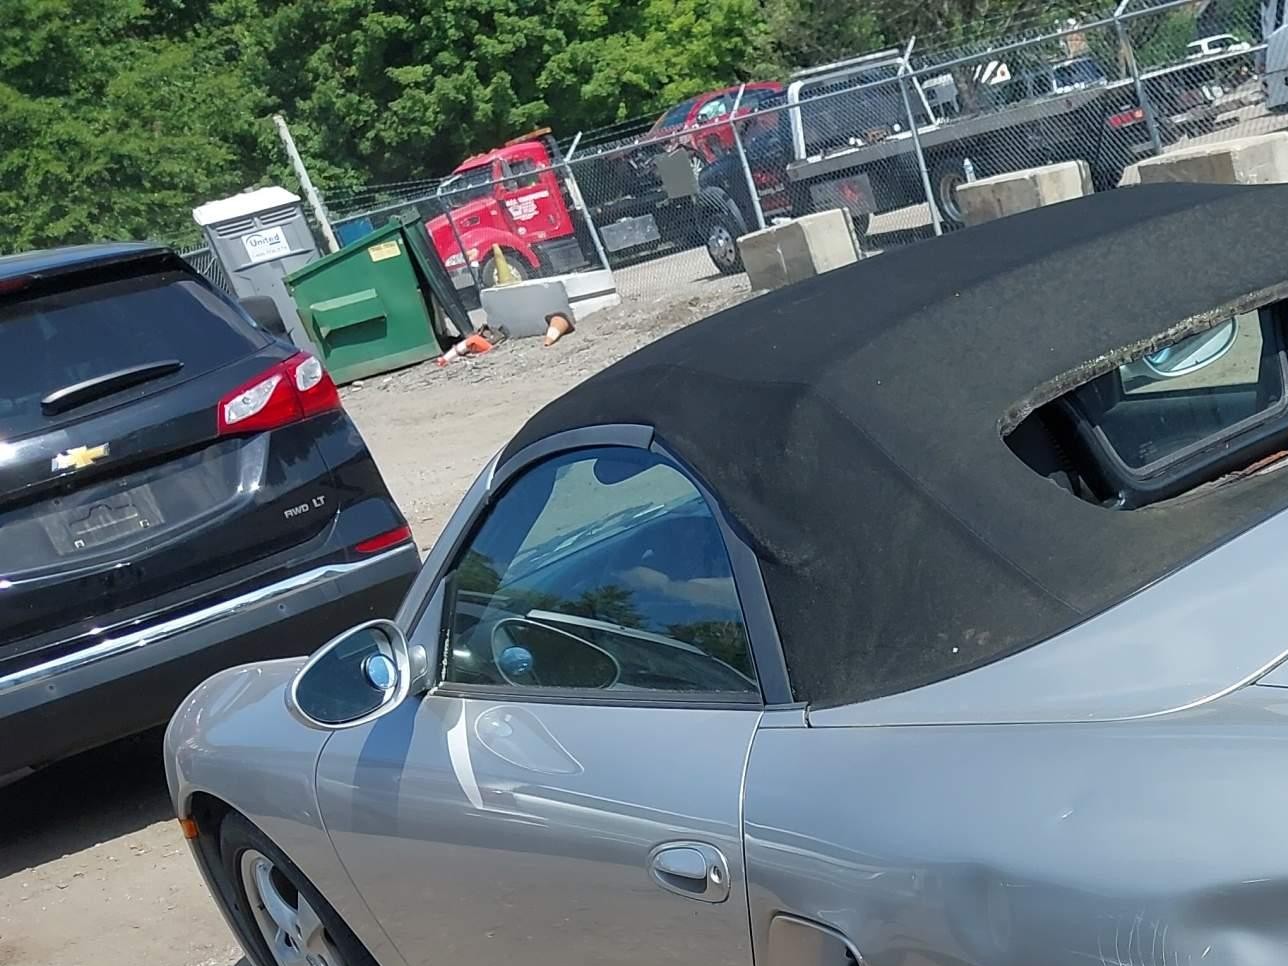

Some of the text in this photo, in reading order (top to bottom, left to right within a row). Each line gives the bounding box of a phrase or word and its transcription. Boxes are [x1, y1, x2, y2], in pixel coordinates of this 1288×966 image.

[249, 232, 280, 247] United
[284, 496, 325, 519] AWD LT
